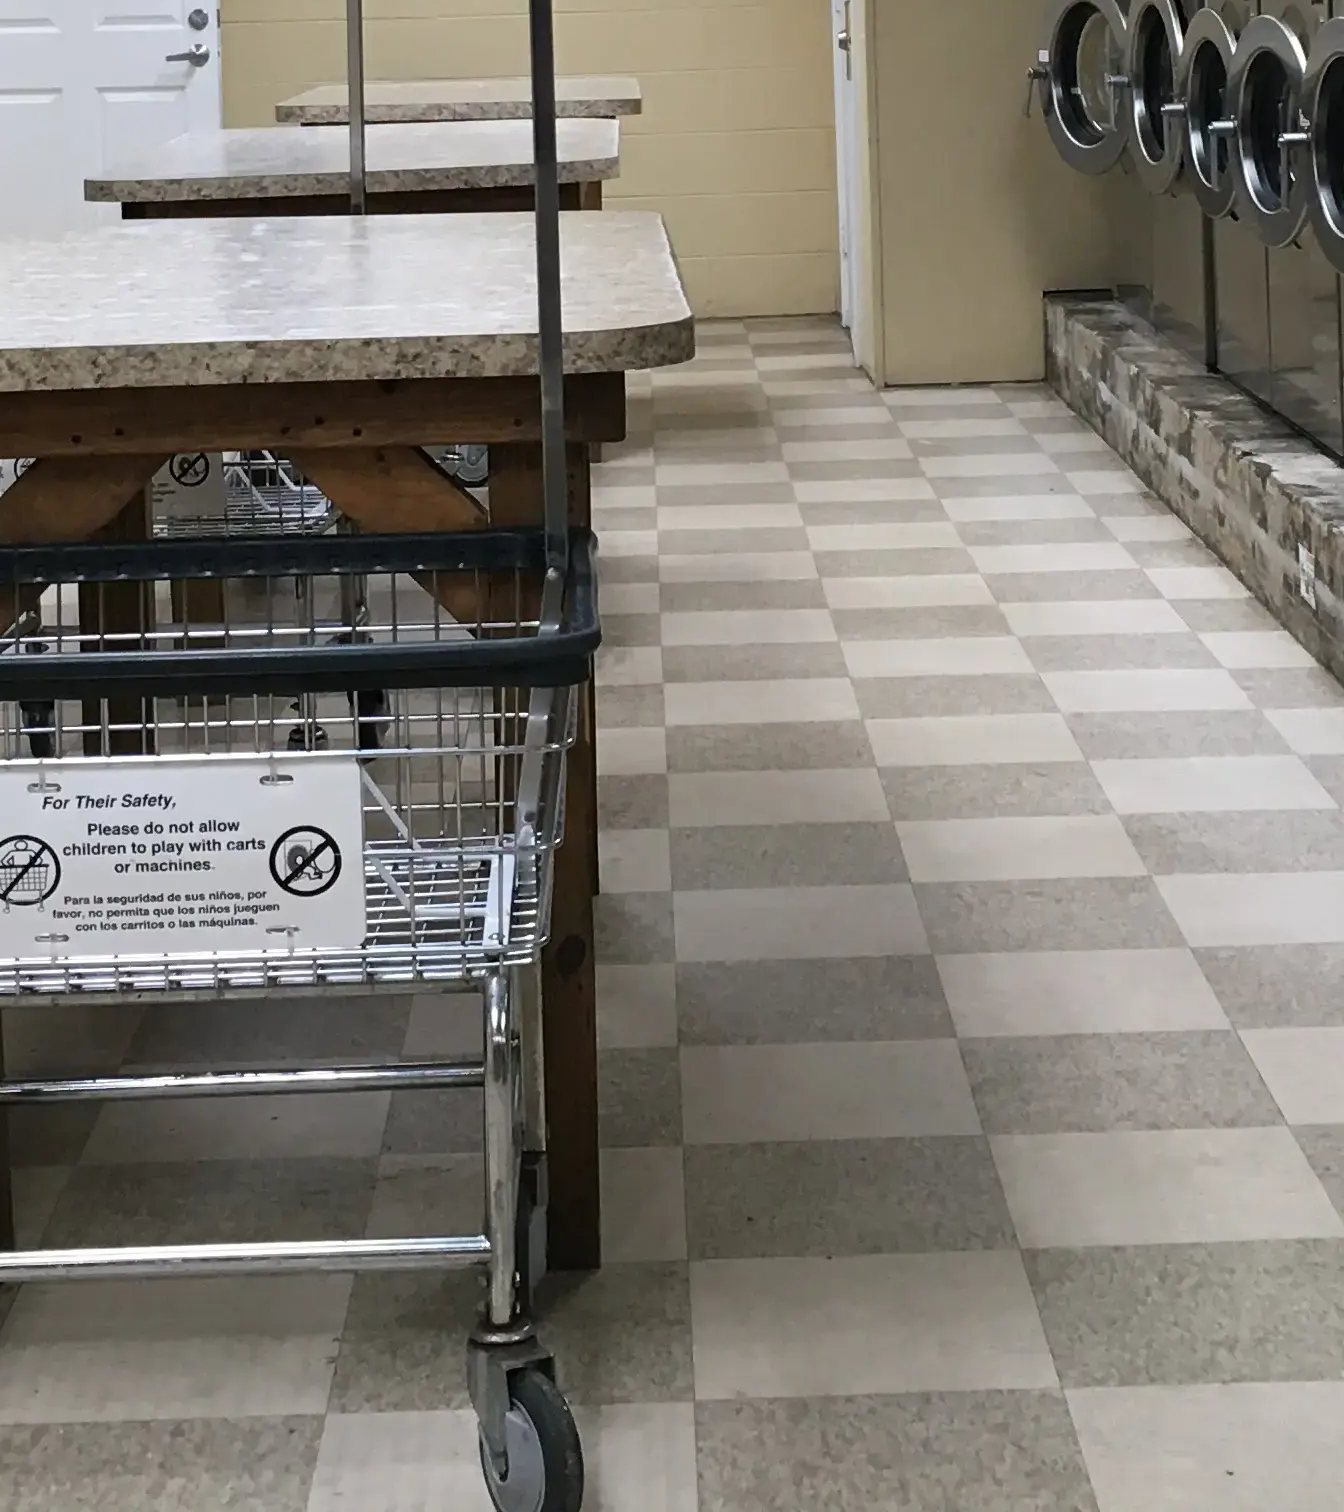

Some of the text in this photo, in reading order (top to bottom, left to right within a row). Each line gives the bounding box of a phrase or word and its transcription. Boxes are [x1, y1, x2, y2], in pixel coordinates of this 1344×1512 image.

[42, 793, 177, 811] For Their Safety,
[87, 819, 240, 836] Please do not allow
[62, 837, 267, 856] children to play with carts
[114, 859, 216, 874] or machines.
[64, 890, 267, 906] Para la seguridad de sus niños, por
[52, 902, 280, 920] favor, no permita que los niños jueguen
[75, 922, 97, 932] con
[100, 921, 118, 931] los
[121, 919, 165, 931] carritos
[167, 920, 176, 929] o
[178, 918, 196, 928] las
